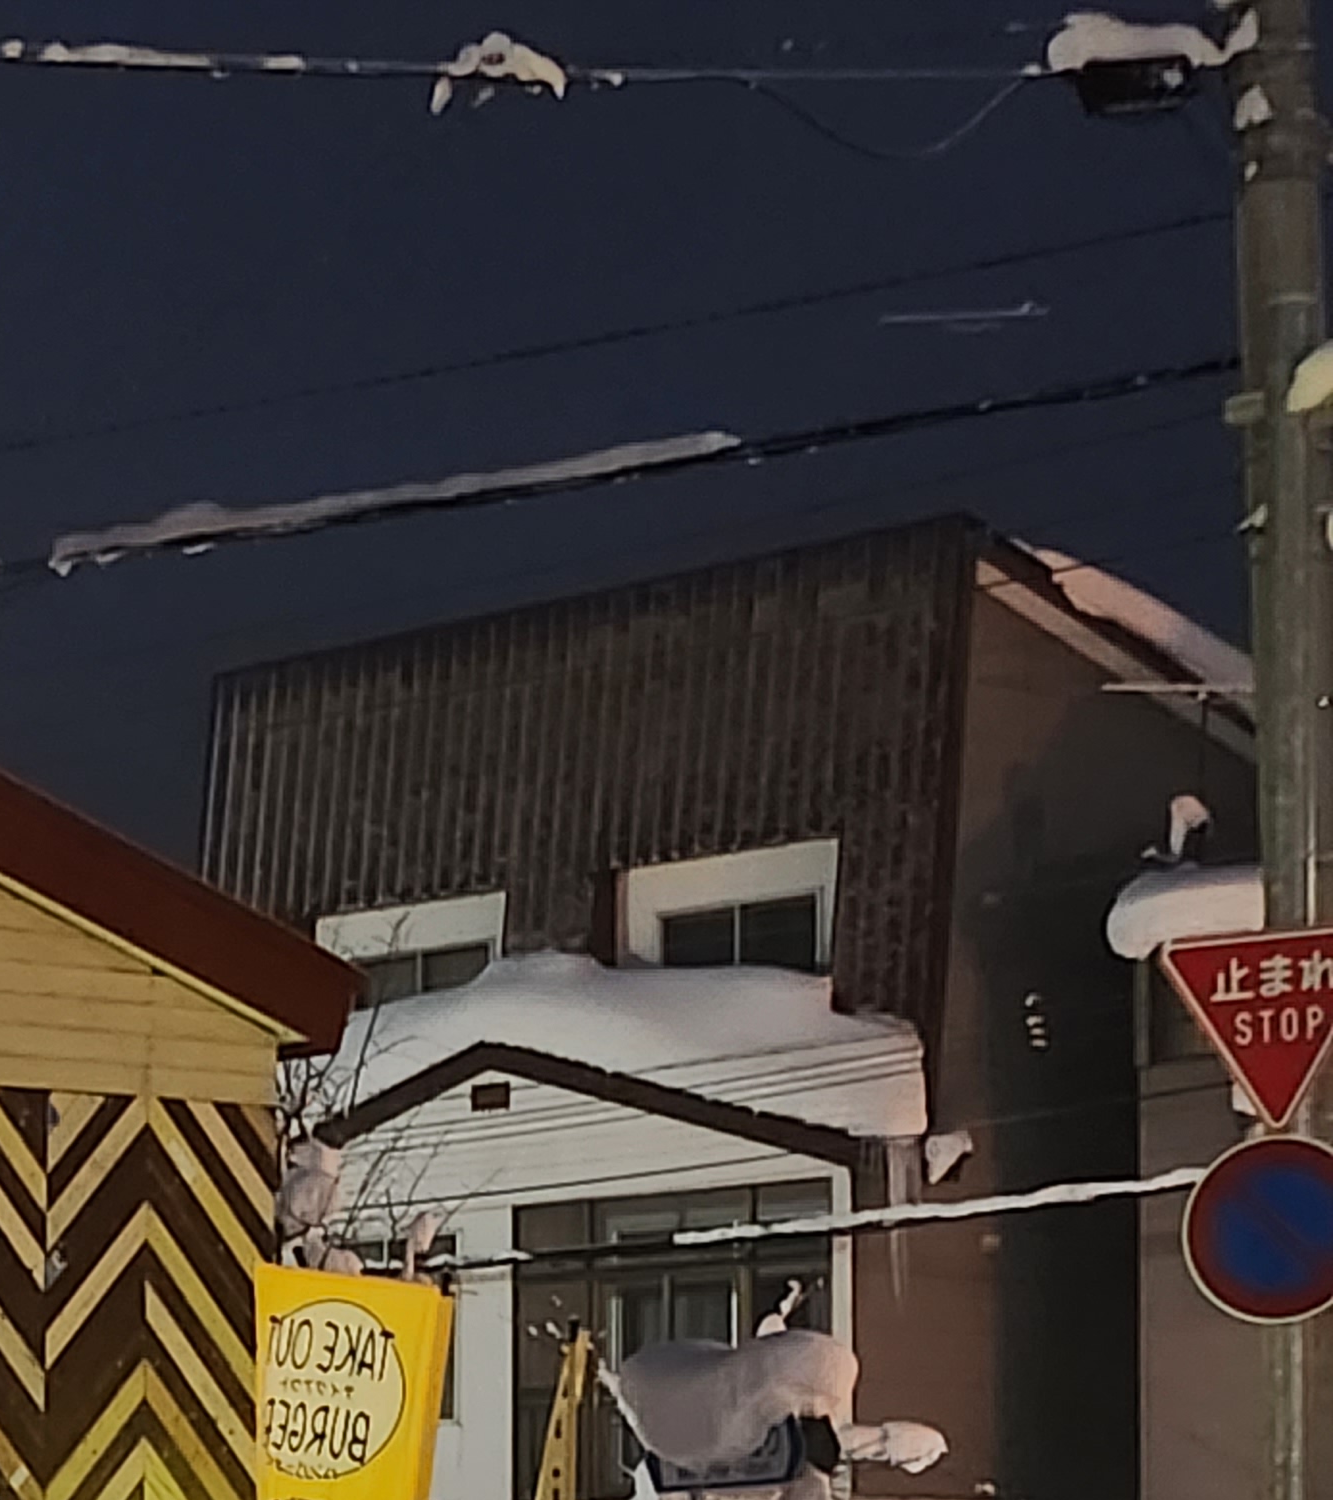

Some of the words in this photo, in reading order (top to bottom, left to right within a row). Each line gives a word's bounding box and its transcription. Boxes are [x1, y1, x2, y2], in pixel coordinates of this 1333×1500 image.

[1209, 949, 1333, 1002] 止まれ
[1235, 1004, 1324, 1045] STOP
